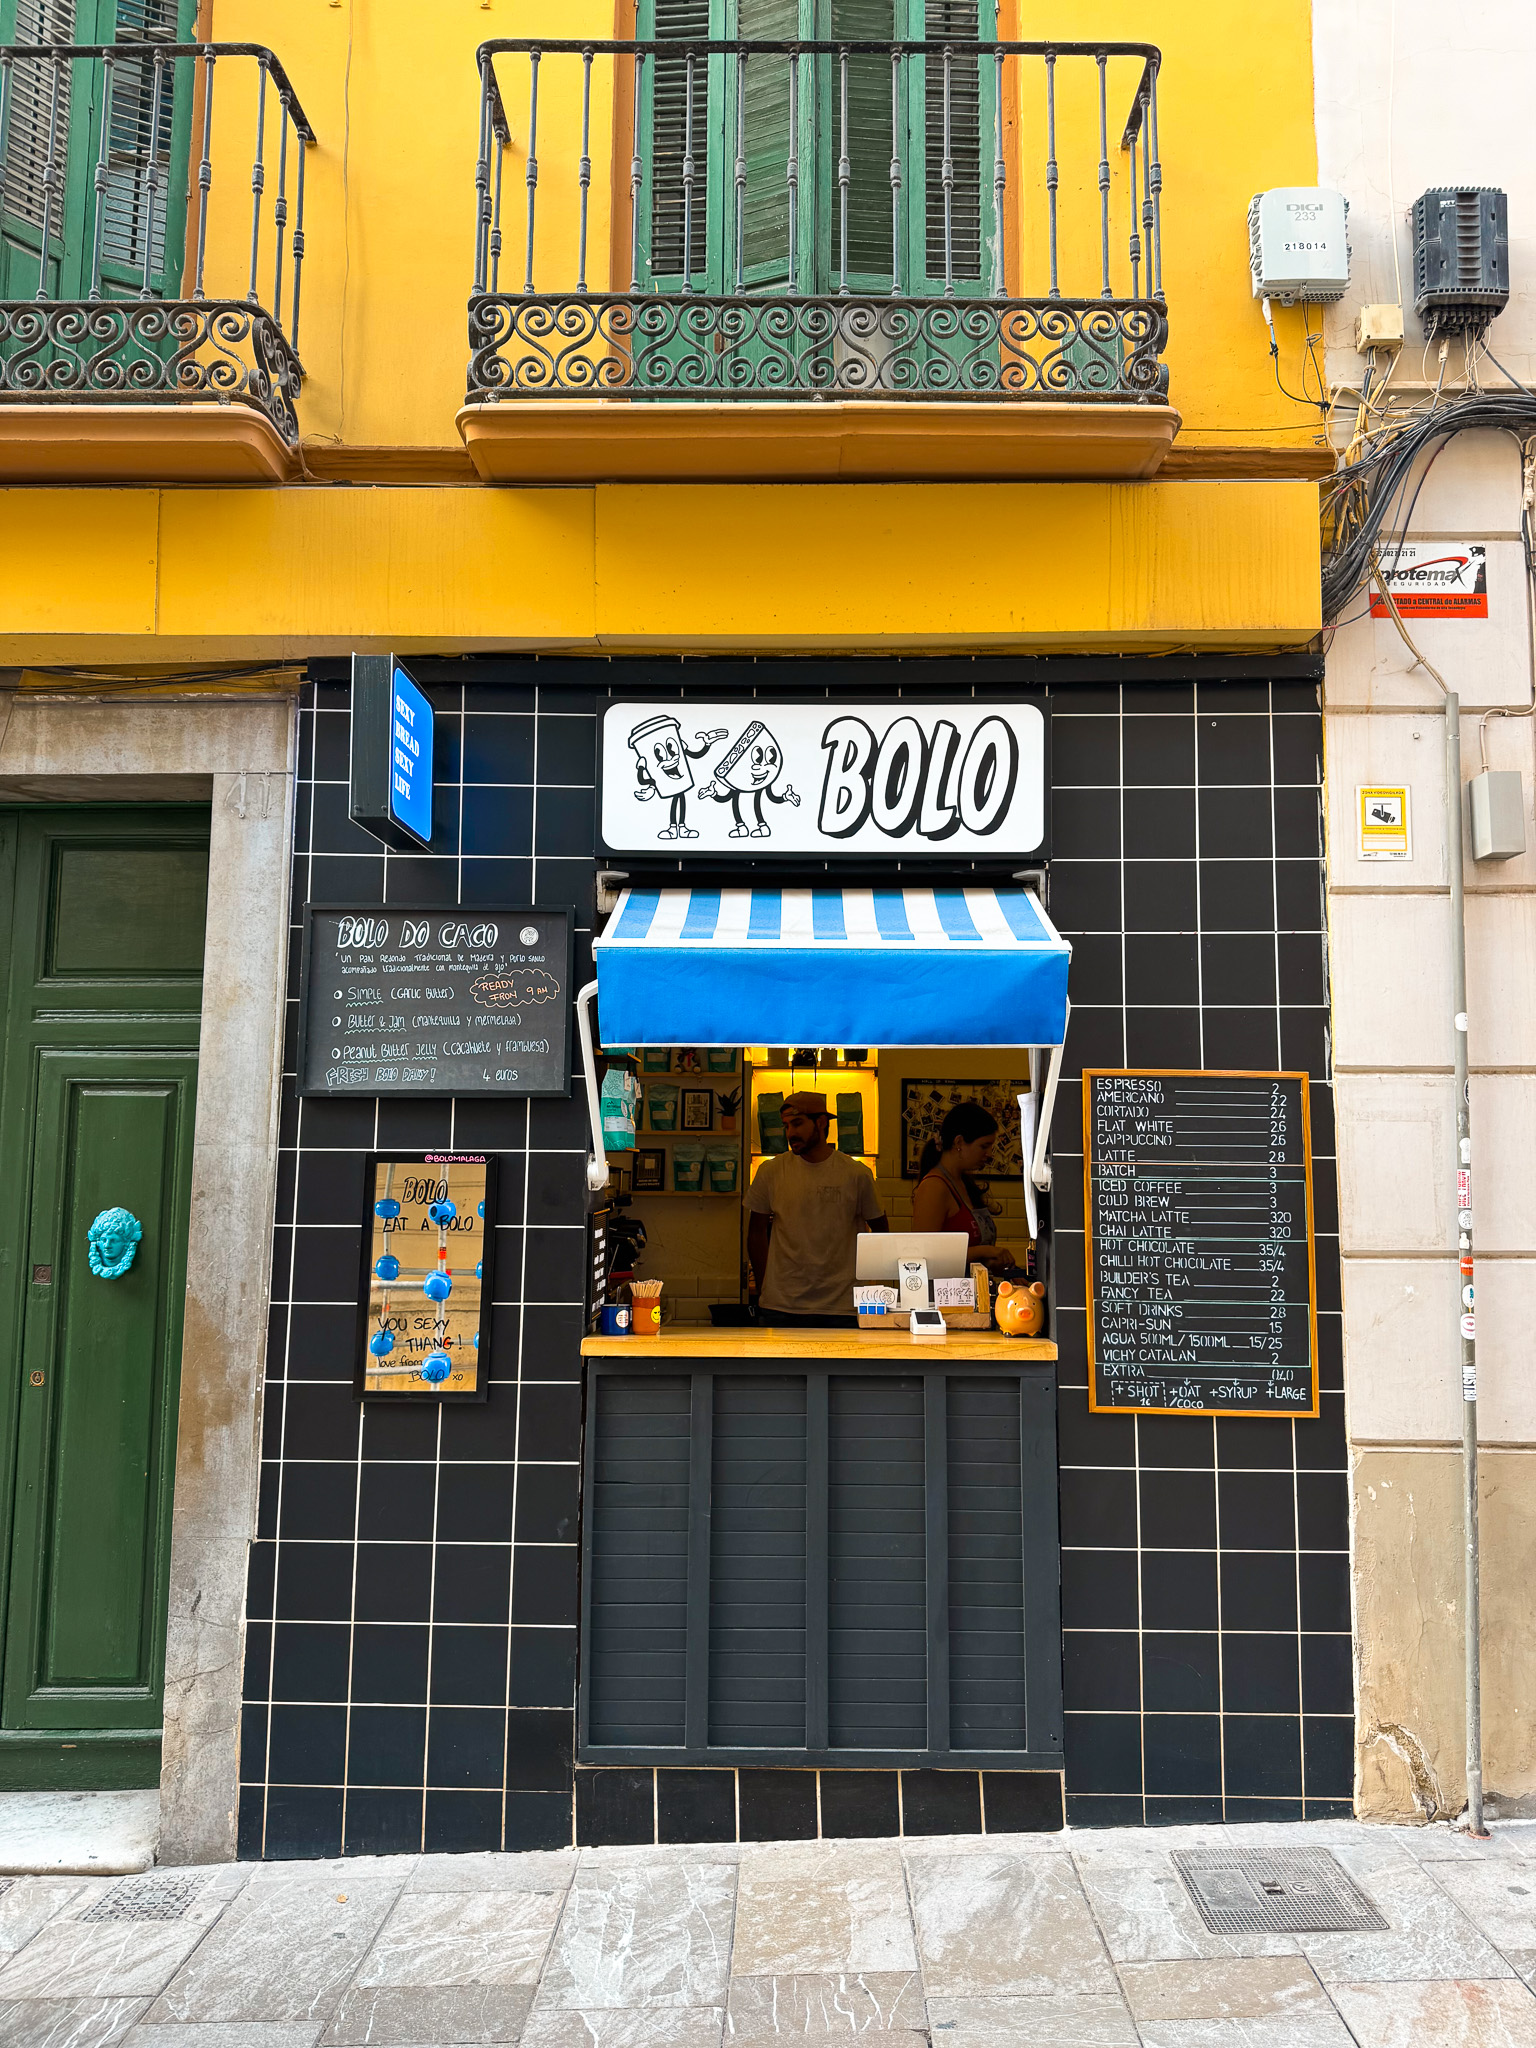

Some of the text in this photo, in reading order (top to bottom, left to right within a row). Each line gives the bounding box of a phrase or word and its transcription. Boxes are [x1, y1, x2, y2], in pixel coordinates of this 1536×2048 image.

[1295, 212, 1316, 221] 233
[396, 695, 415, 727] SEXY
[395, 720, 419, 757] BREAD
[395, 747, 414, 777] SEXY
[817, 715, 1020, 841] BOLO
[394, 772, 411, 800] LIFE
[337, 916, 498, 948] BOLO DO CACO
[478, 980, 514, 991] READY
[348, 987, 382, 1000] SIMPLE
[489, 991, 517, 1001] FROM
[526, 987, 534, 995] 9
[379, 1019, 385, 1027] &
[326, 1066, 369, 1086] FRESH
[375, 1067, 398, 1082] BOLO
[482, 1068, 490, 1082] 4
[1097, 1079, 1279, 1095] ESPRESSO 2
[1097, 1092, 1164, 1104] AMERICANO
[1097, 1105, 1149, 1118] CORTADO
[1098, 1120, 1126, 1132] FLAT
[1135, 1121, 1173, 1133] WHITE
[1098, 1133, 1172, 1146] CAPPUCCINO
[425, 1154, 486, 1162] @BOLOMALAGA
[1098, 1149, 1136, 1162] LATTE
[1098, 1165, 1277, 1178] BATCH 3
[402, 1176, 448, 1205] BOLO
[1099, 1181, 1277, 1194] ICED COFFEE 3
[1098, 1194, 1277, 1208] COLD BREW 3
[383, 1215, 474, 1233] EAT A BOLO
[1099, 1210, 1146, 1222] MATCHA
[1151, 1211, 1190, 1224] LATTE
[1099, 1225, 1127, 1236] CHAI
[1133, 1226, 1172, 1238] LATTE
[1100, 1239, 1123, 1251] HOT
[1128, 1241, 1195, 1253] CHOCOLATE
[1100, 1255, 1133, 1267] CHILLI
[1138, 1257, 1160, 1268] HOT
[1164, 1257, 1232, 1270] CHOCOLATE
[1101, 1271, 1279, 1287] BUILDER'S TEA 2
[1101, 1287, 1140, 1299] FANCY
[1147, 1288, 1173, 1300] TEA
[1102, 1302, 1132, 1314] SOFT
[1139, 1305, 1183, 1317] DRINKS
[378, 1318, 450, 1340] YOU SEXY
[1101, 1317, 1171, 1330] CAPRI-SUN
[1102, 1333, 1136, 1345] AGUA
[378, 1356, 422, 1368] love from
[1103, 1349, 1279, 1364] VICHY CATALAN 2
[408, 1369, 445, 1383] BOLO
[1103, 1365, 1145, 1376] EXTRA
[1127, 1386, 1159, 1397] SHOT
